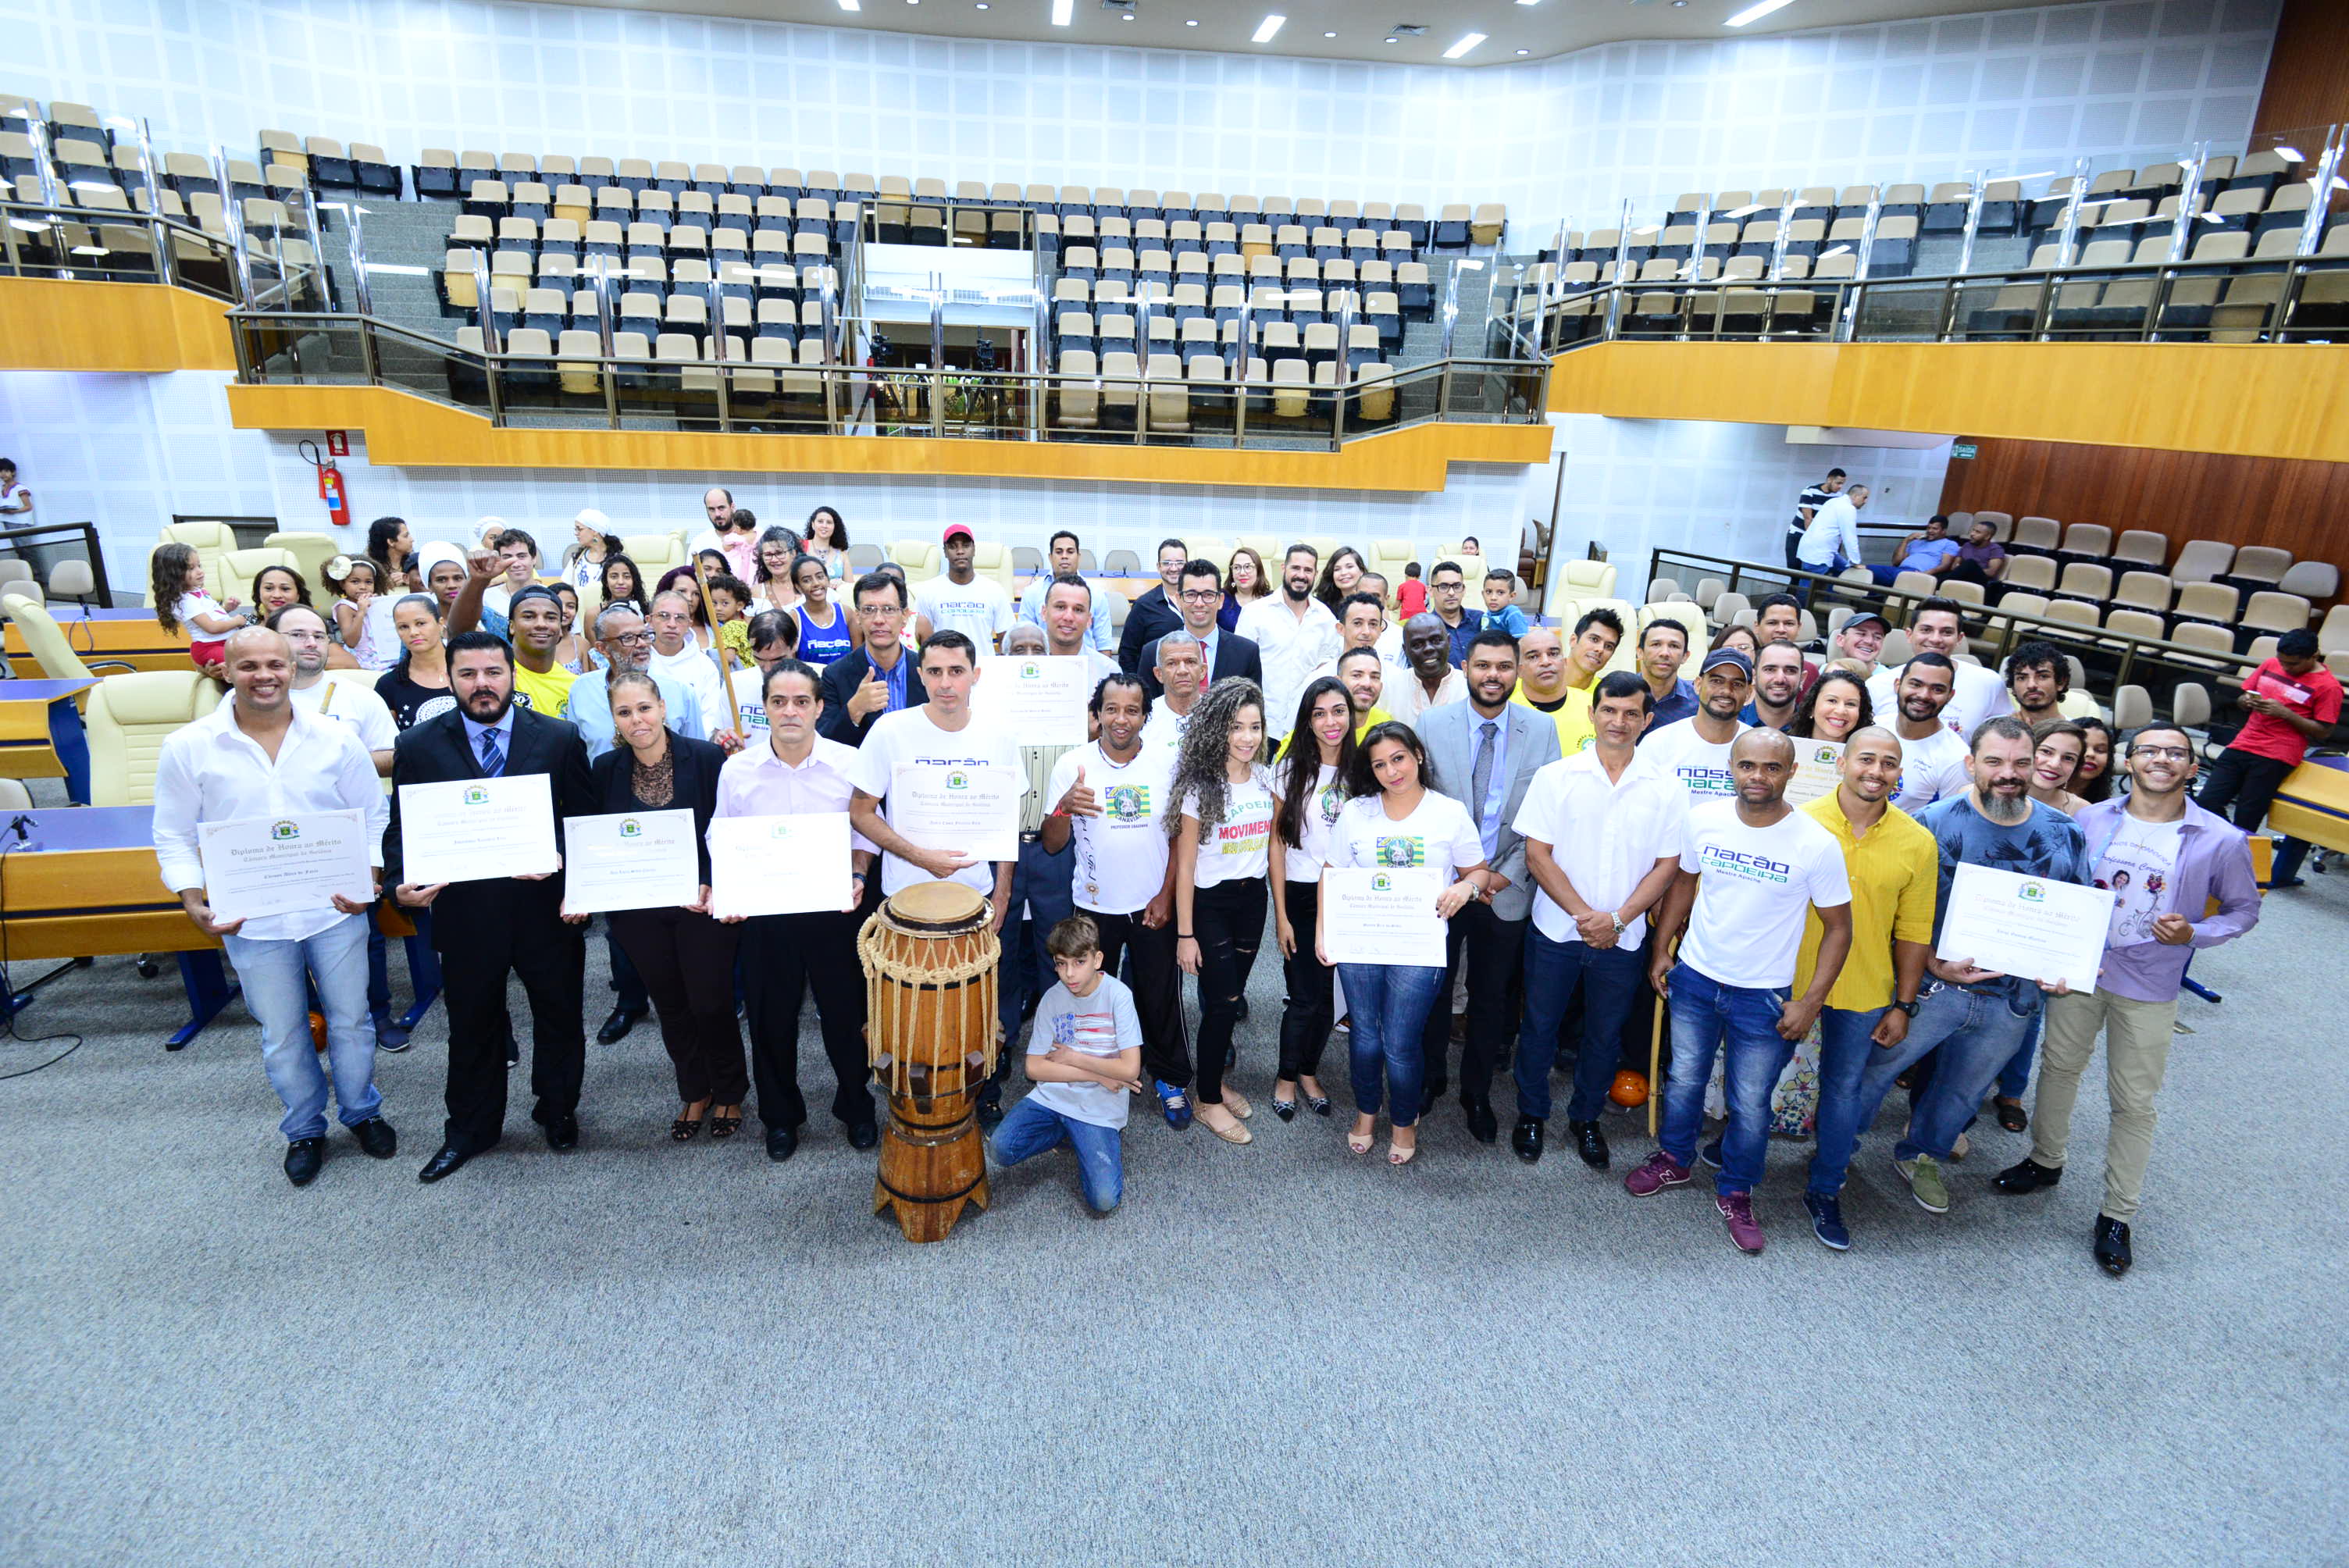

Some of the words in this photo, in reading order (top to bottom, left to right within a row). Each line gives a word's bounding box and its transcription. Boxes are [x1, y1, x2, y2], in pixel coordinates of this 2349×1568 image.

[1677, 768, 1734, 779] noss
[1219, 819, 1271, 839] MOVIMEN
[230, 846, 264, 857] Diploma
[277, 843, 302, 852] Honra
[315, 838, 342, 847] Mérito
[1701, 856, 1788, 883] capoeira
[1703, 846, 1790, 875] nação
[1716, 868, 1737, 877] Mestre
[1738, 873, 1761, 884] Apache
